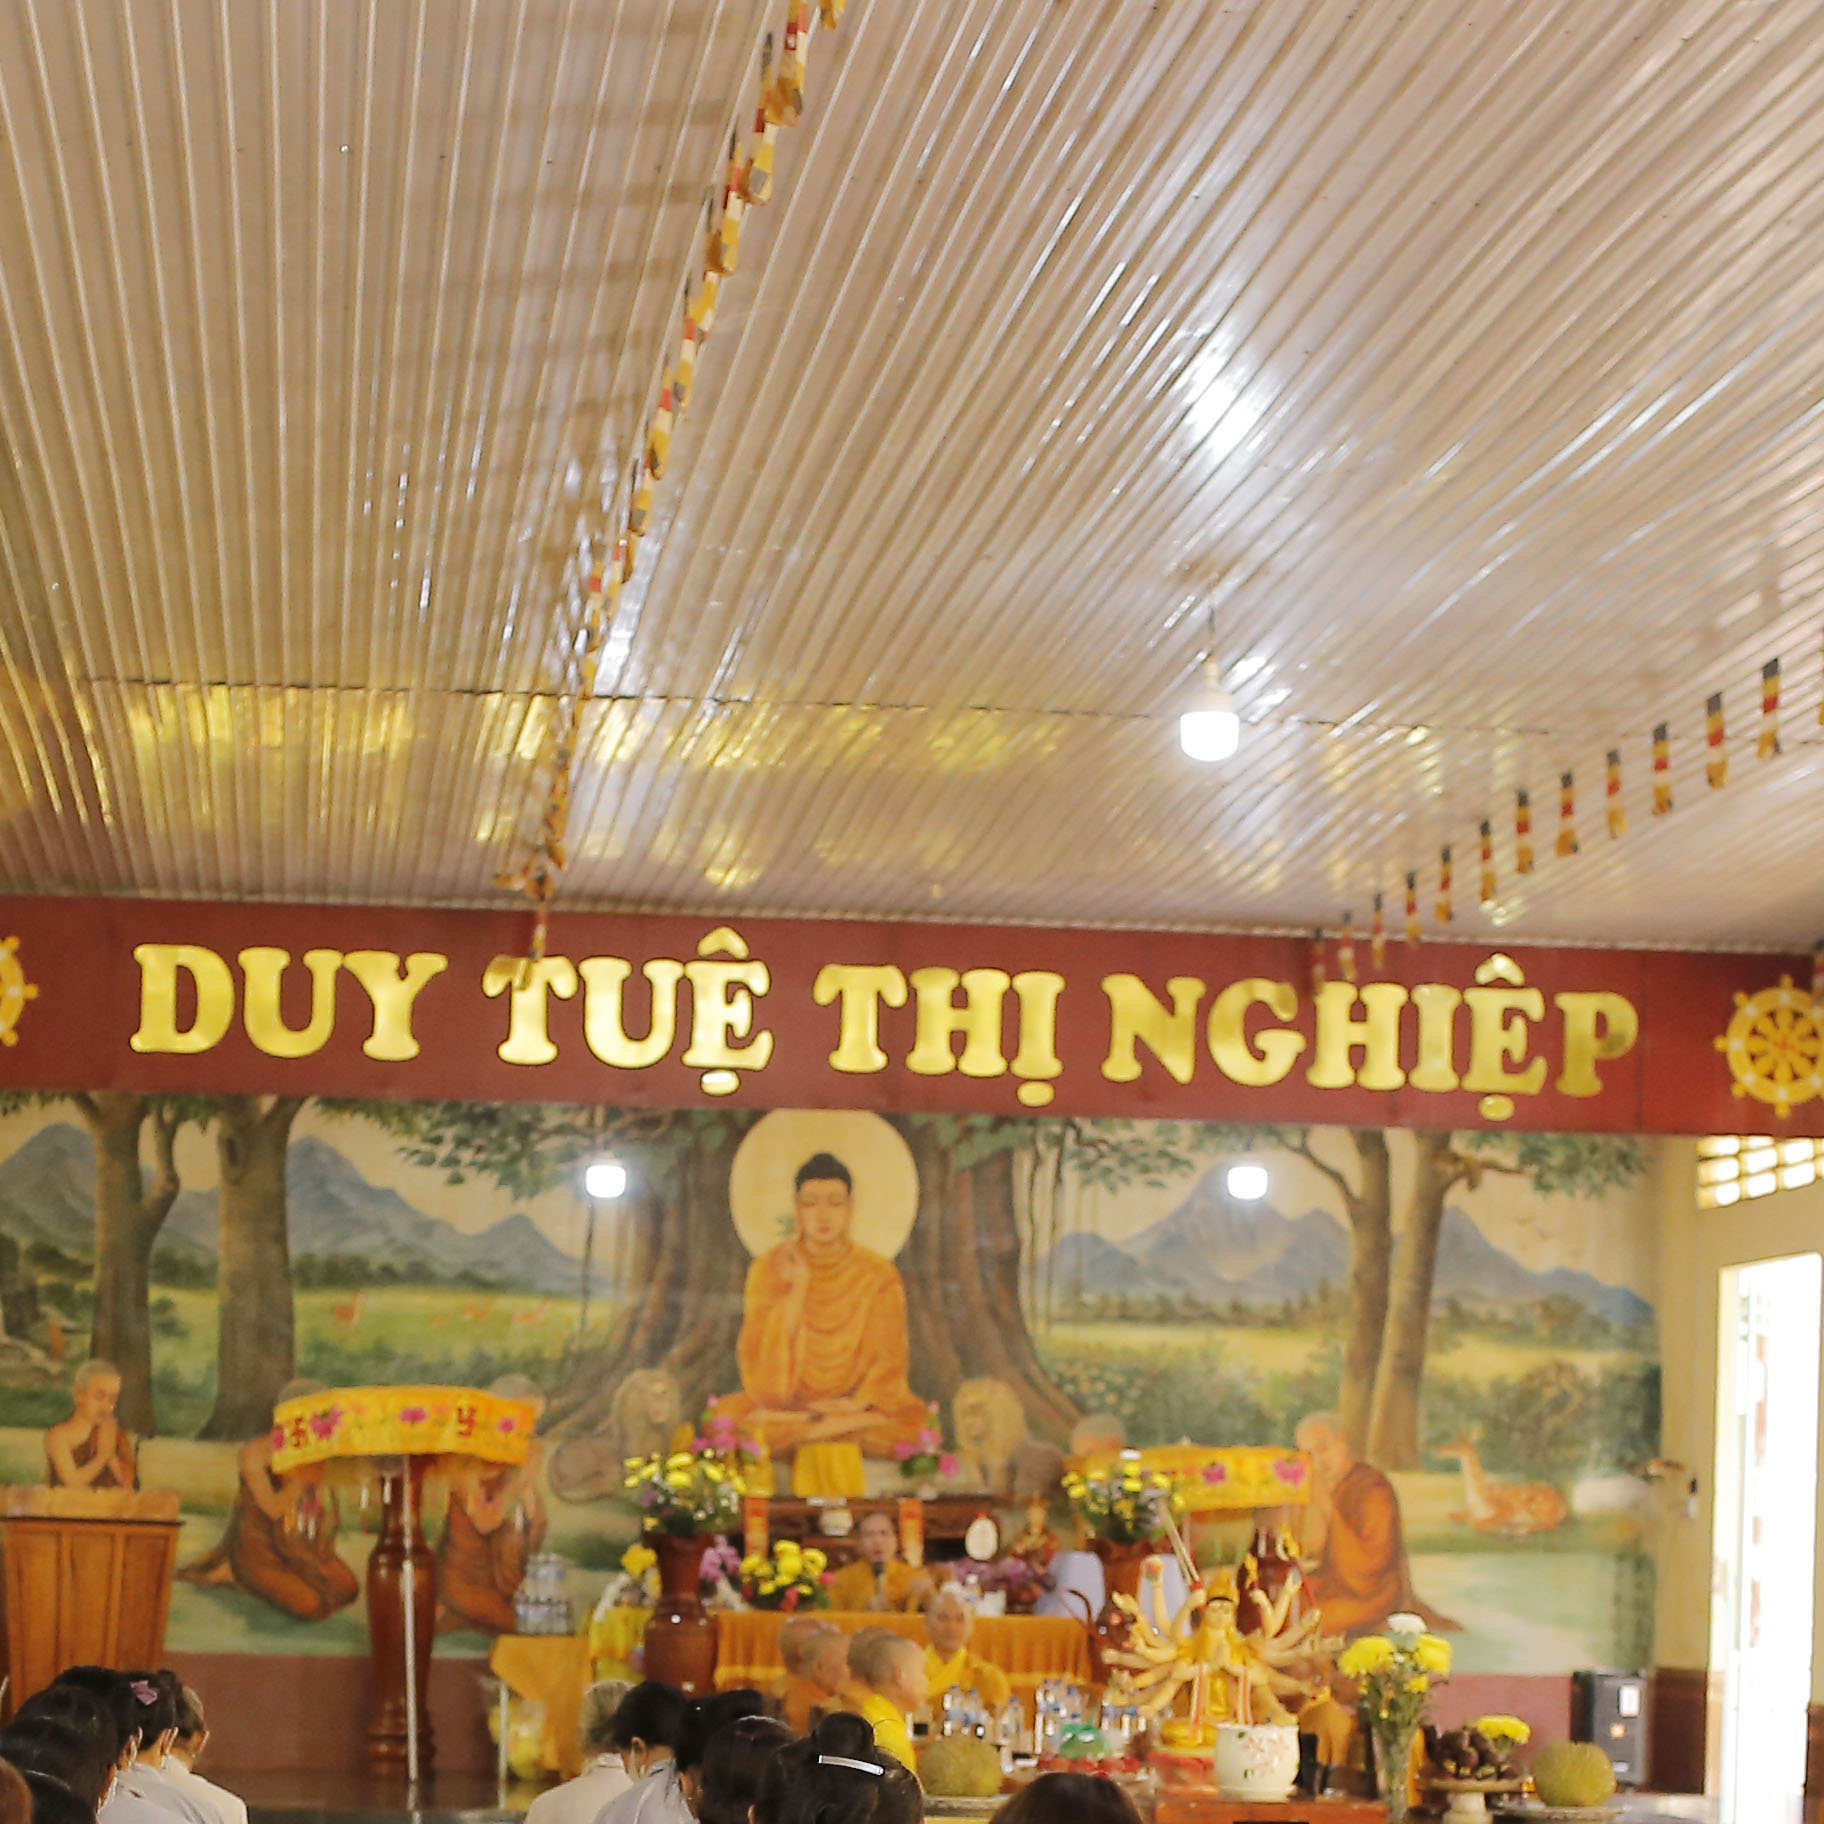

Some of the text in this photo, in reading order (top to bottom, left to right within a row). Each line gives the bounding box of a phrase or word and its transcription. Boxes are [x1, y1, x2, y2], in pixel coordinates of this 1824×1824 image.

[130, 926, 1639, 1121] DUY TUỆ THỊ NGHIỆP
